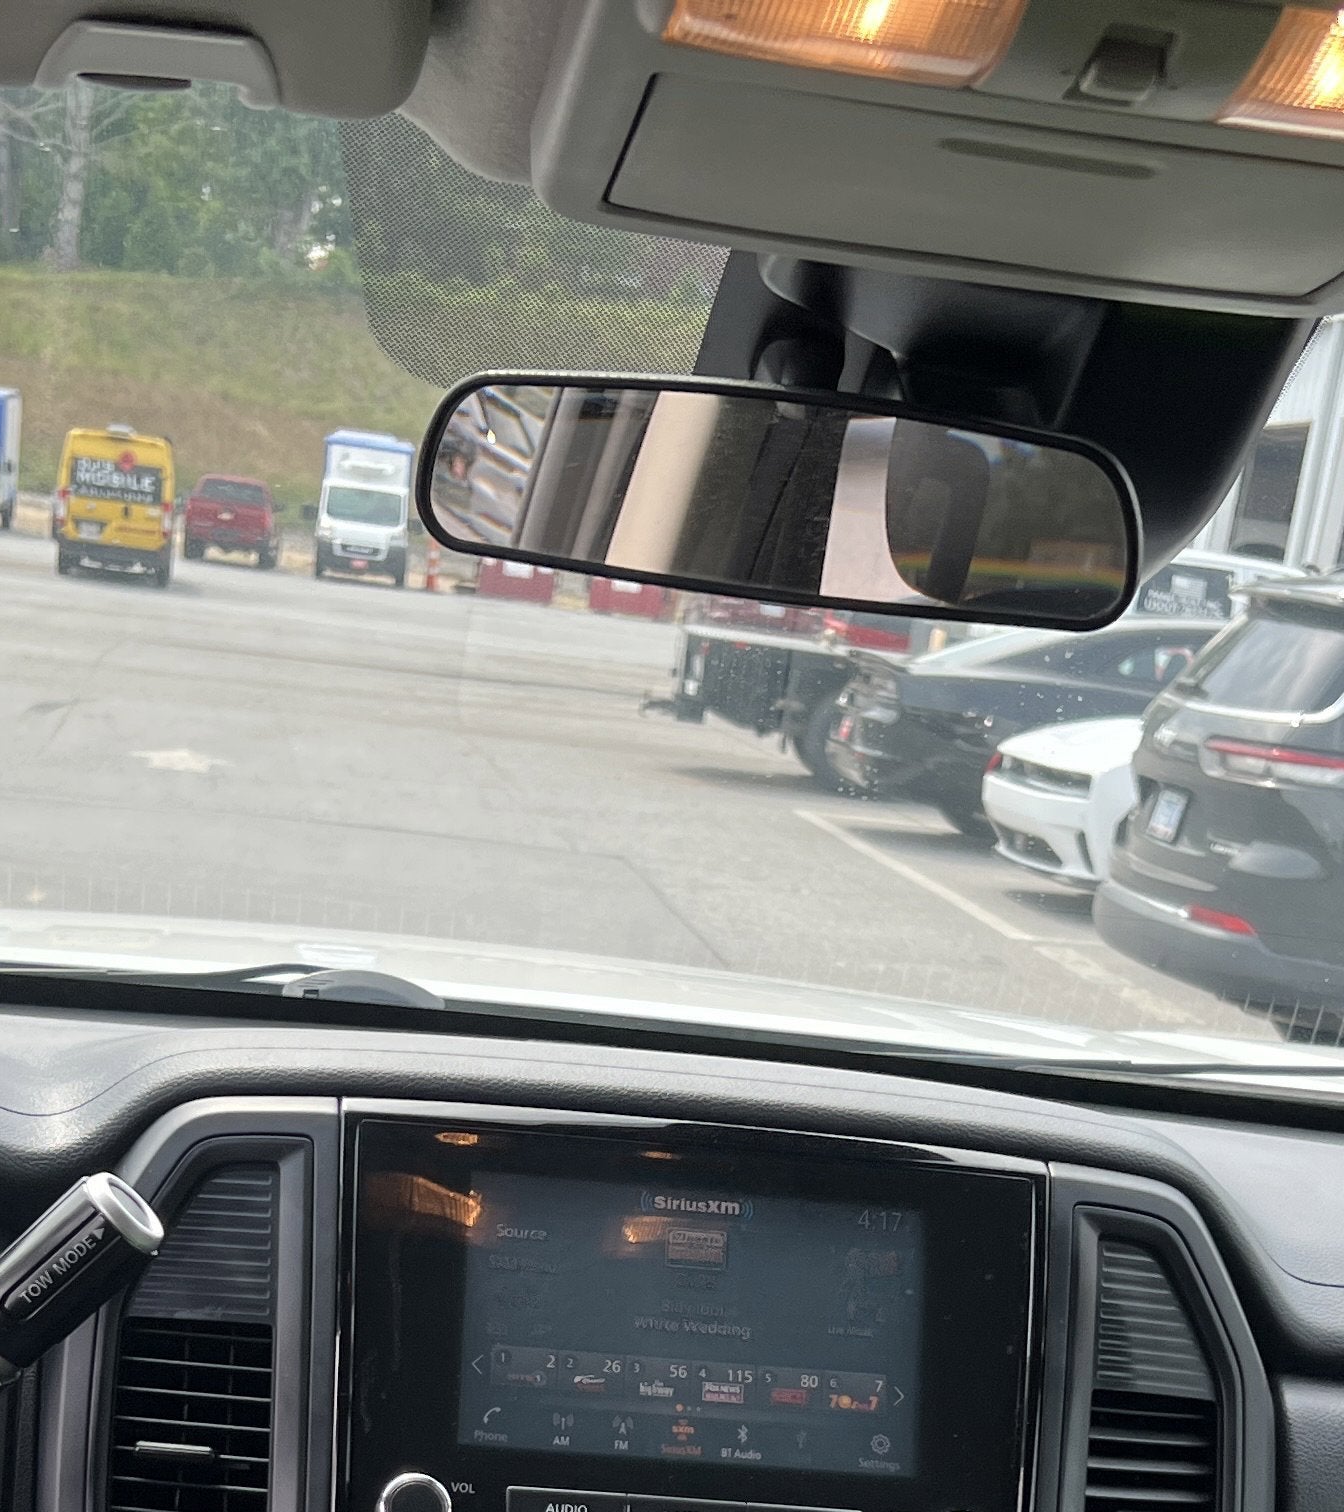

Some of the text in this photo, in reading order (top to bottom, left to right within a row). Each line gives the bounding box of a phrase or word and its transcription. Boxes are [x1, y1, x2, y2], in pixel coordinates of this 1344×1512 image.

[857, 1209, 902, 1232] 4:17
[496, 1224, 547, 1241] Source
[19, 1236, 97, 1304] TOW MODE
[682, 1318, 753, 1342] Wedding
[546, 1354, 556, 1368] 2
[566, 1358, 574, 1368] 2
[605, 1359, 621, 1373] 26
[634, 1363, 640, 1372] 3
[669, 1364, 688, 1378] 56
[699, 1368, 706, 1378] 4
[728, 1369, 753, 1383] 115
[766, 1373, 772, 1383] 5
[800, 1374, 818, 1388] 80
[829, 1378, 837, 1388] 6
[876, 1381, 883, 1392] 7
[474, 1430, 508, 1442] Phone
[553, 1436, 570, 1446] AM
[614, 1440, 629, 1450] FM
[734, 1449, 762, 1461] Audio
[859, 1457, 901, 1472] Settings
[451, 1481, 476, 1494] VOL
